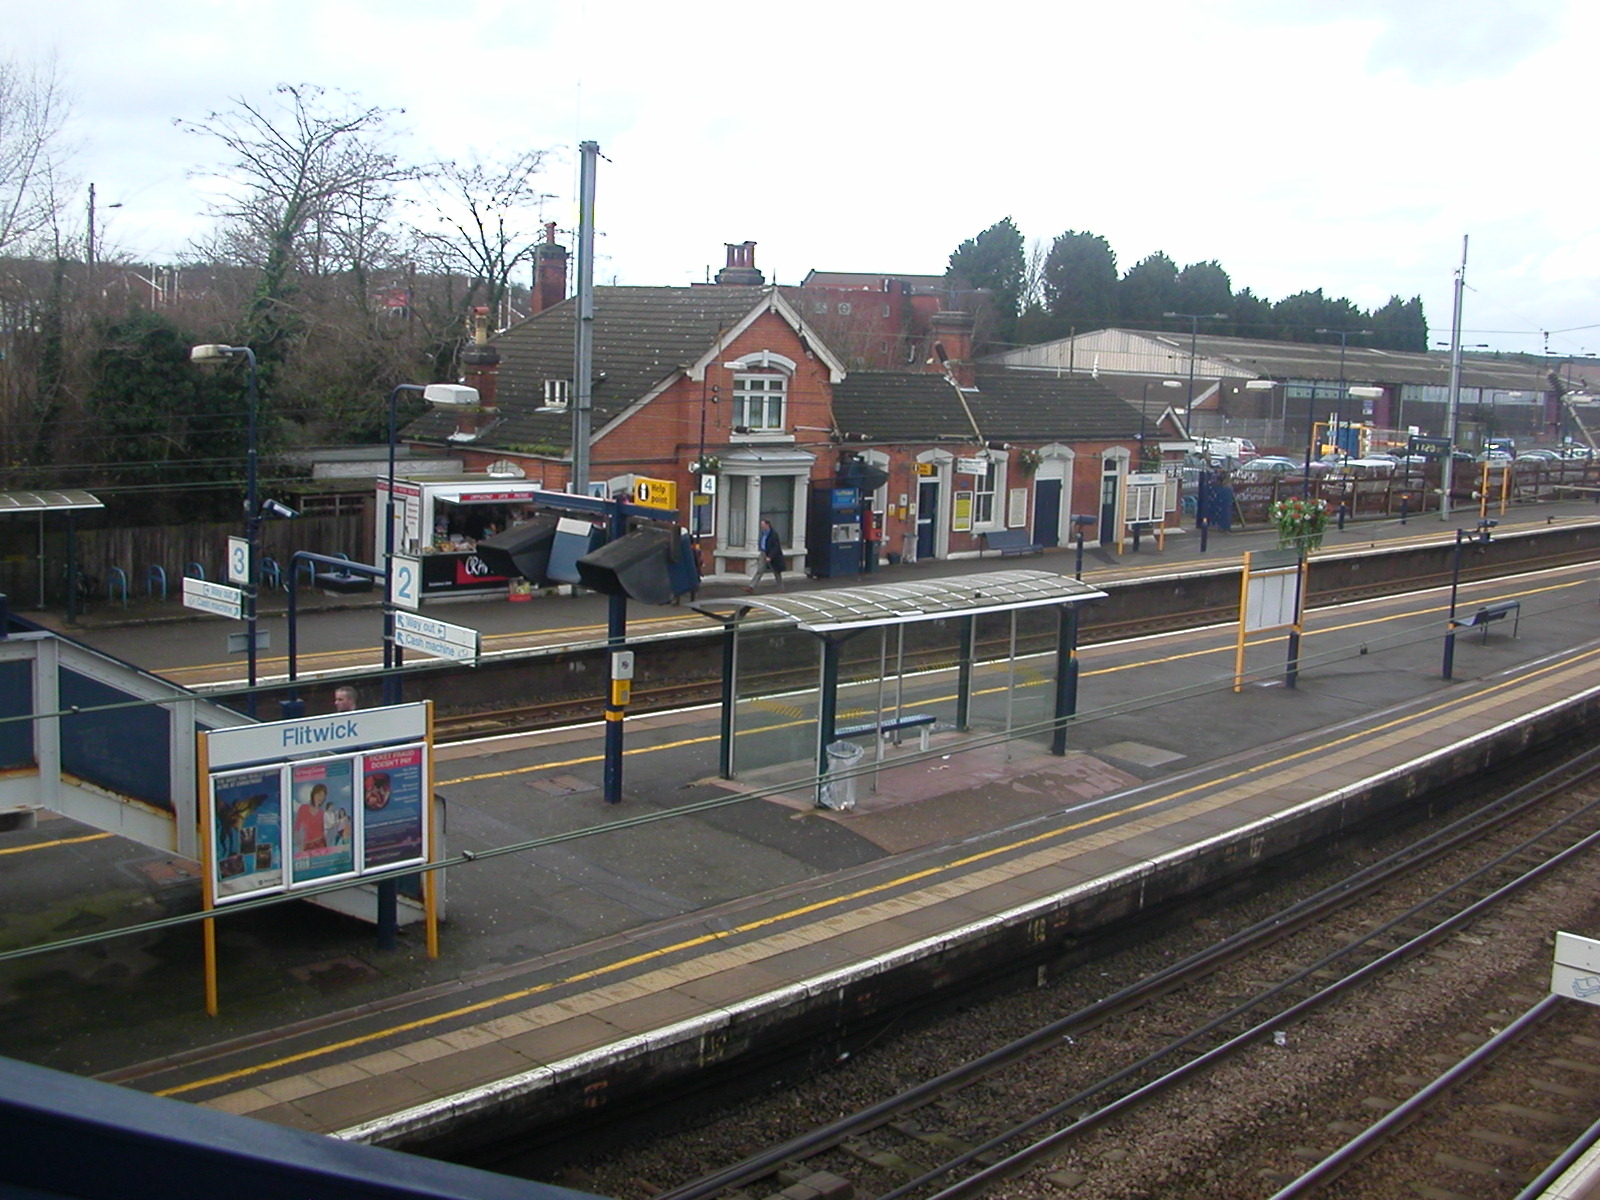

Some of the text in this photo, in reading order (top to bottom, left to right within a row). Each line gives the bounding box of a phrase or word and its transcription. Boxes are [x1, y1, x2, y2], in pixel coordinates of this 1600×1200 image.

[651, 483, 667, 494] Help
[704, 477, 713, 491] 4
[651, 494, 668, 505] point
[233, 546, 245, 575] 3
[397, 565, 412, 599] 2
[405, 615, 436, 634] Way out
[405, 633, 455, 657] Cash machine
[283, 719, 359, 748] Flitwick
[371, 757, 413, 769] DOESN'T PAY
